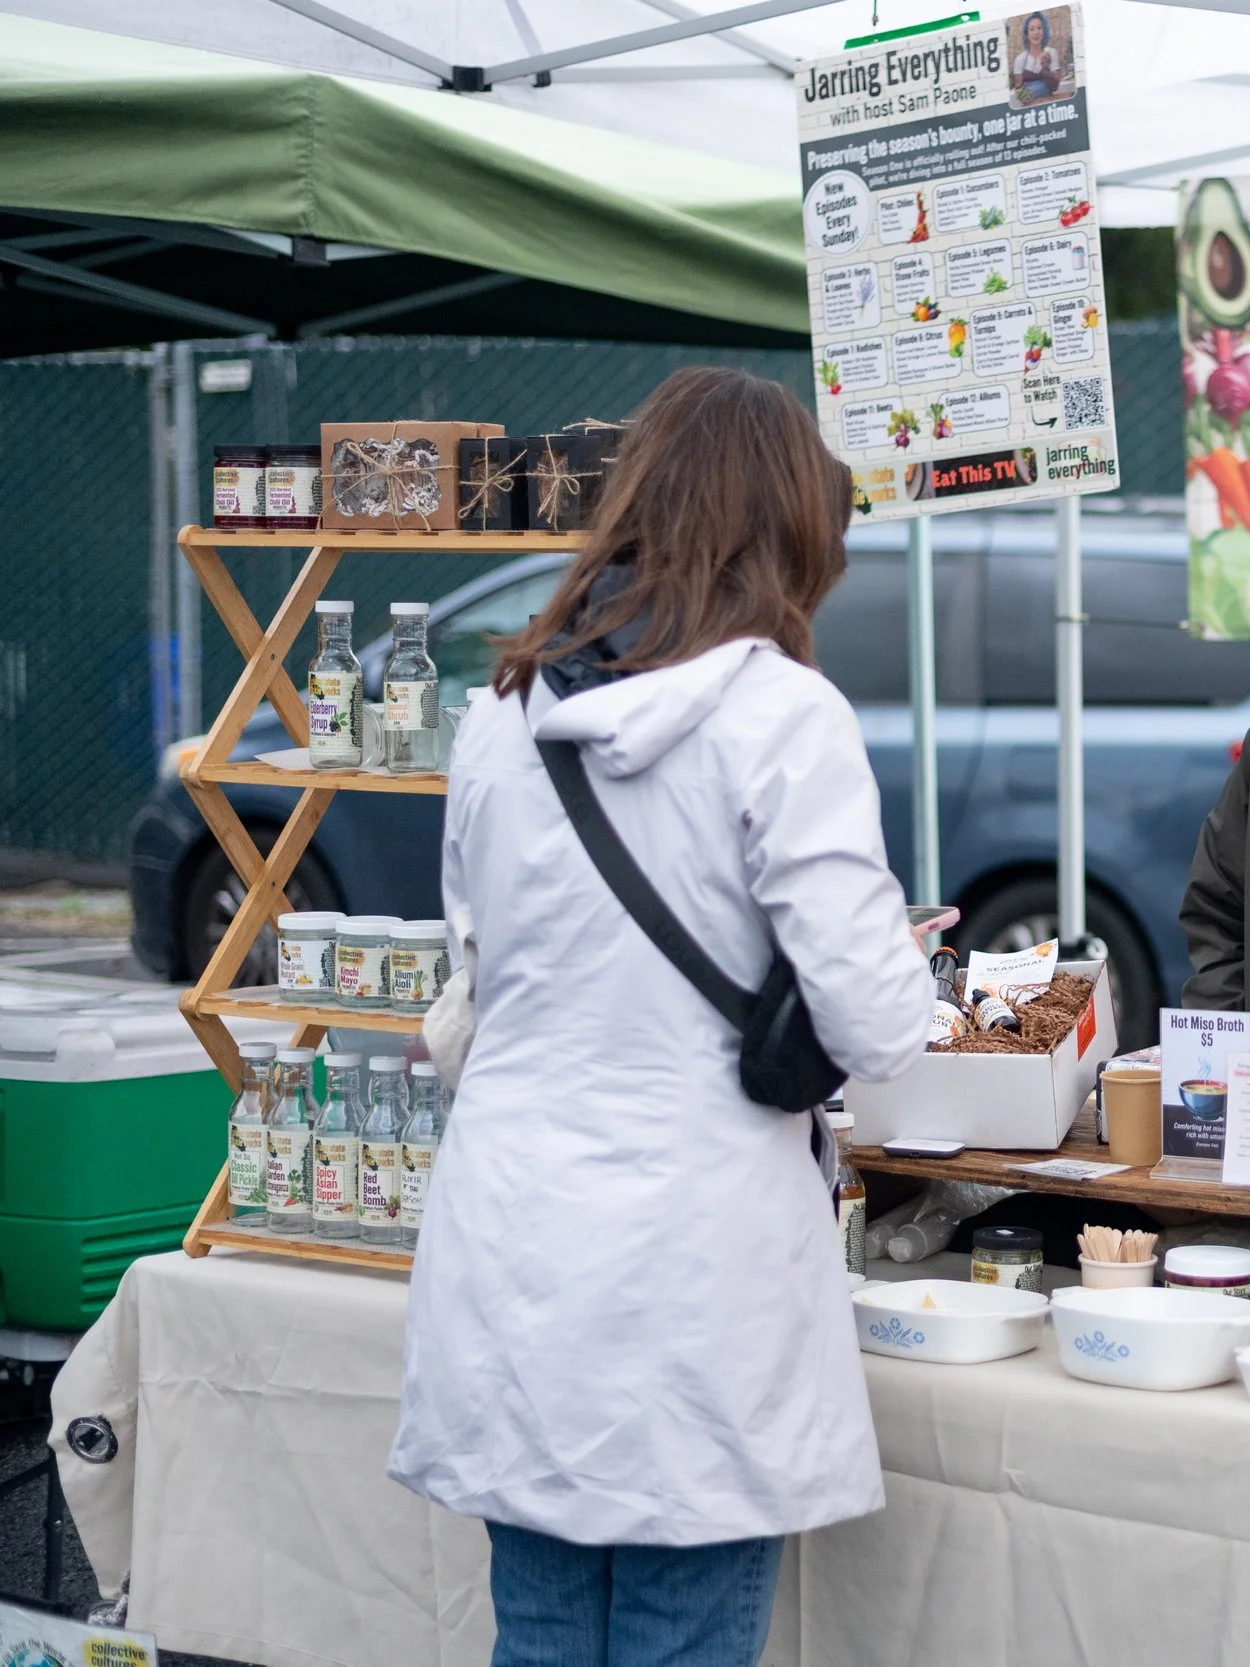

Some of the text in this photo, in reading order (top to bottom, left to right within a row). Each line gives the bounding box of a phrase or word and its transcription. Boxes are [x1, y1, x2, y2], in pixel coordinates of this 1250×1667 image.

[805, 35, 1000, 102] Jarring Everything
[830, 84, 977, 127] with host Sam Paone
[807, 103, 1079, 171] Preserving the season's bounty, one jar at a time.
[824, 182, 844, 196] New
[826, 214, 851, 230] Every
[1046, 444, 1089, 466] jarring
[931, 460, 1016, 488] Eat This TV
[1048, 458, 1116, 480] everything
[340, 976, 358, 986] Mayo
[1171, 1015, 1245, 1032] Hot Miso Broth
[1201, 1033, 1214, 1047] $5
[1174, 1122, 1202, 1132] Comforting
[1203, 1123, 1211, 1132] hot
[316, 1167, 336, 1179] Spicy
[364, 1172, 377, 1184] Red
[316, 1179, 337, 1189] Asian
[364, 1184, 381, 1195] Beet
[316, 1190, 342, 1202] Sipper
[363, 1194, 386, 1206] Bomb
[91, 1642, 146, 1660] collective
